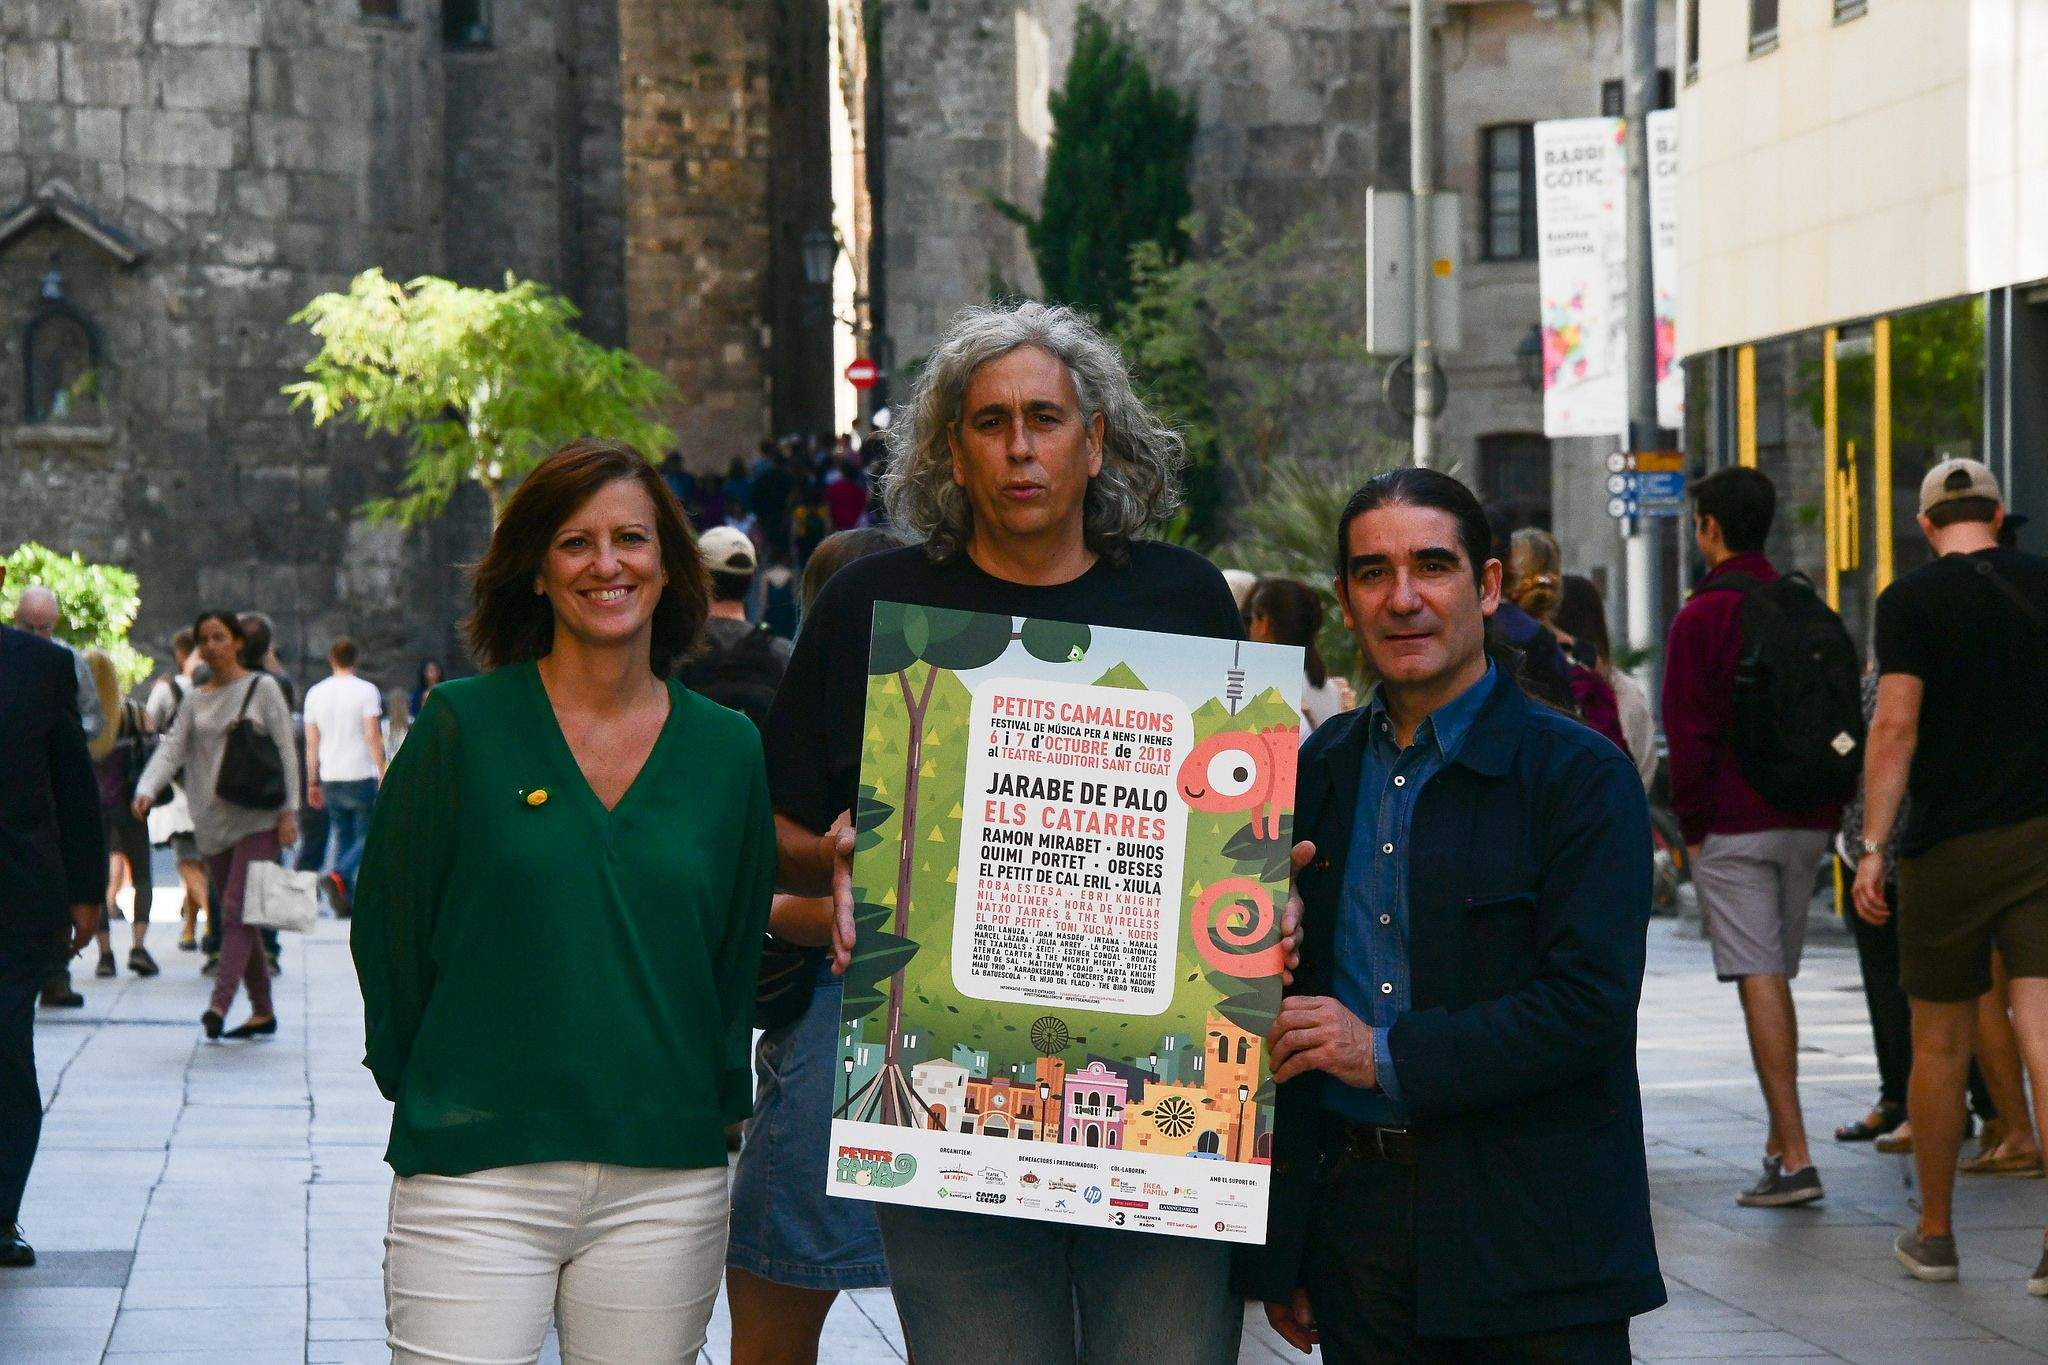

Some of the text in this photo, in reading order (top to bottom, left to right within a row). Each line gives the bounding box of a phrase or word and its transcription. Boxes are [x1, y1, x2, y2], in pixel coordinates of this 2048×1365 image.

[992, 695, 1173, 733] PETITS CAMALEONS
[990, 729, 1171, 763] 6 i 7 d'OCTUBRE de 2018
[991, 718, 1172, 746] FESTIVAL DE MÚSICA PER A NENS I NENES
[988, 745, 1170, 776] al TEATRE-AUDITORI SANT CUGAT
[985, 771, 1167, 813] JARABE DE PALO
[984, 800, 1165, 841] ELS CATARRES
[982, 827, 1164, 860] RAMON MIRABET BUHOS
[980, 845, 1162, 878] QUIMI PORTET OBESES
[979, 862, 1161, 895] EL PETIT DE CAL ERIL XIULA
[977, 890, 1159, 918] NIL MOLINER HORA DE JOGLAR
[978, 879, 1160, 907] ROBA ESTESA EBRI KNIGHT
[976, 912, 986, 922] EL
[992, 914, 1009, 925] POT
[1015, 916, 1041, 928] PETIT
[1055, 921, 1077, 932] TONI
[1128, 928, 1158, 941] KOERS
[977, 901, 1010, 913] NATXO
[1017, 903, 1058, 919] TARRÉS
[1077, 912, 1097, 923] THE
[1103, 915, 1159, 930] WIRELESS
[974, 930, 999, 940] MARCEL
[975, 923, 994, 931] JORDI
[1035, 930, 1052, 938] JOAN
[1129, 940, 1157, 949] MARALA
[1004, 949, 1032, 958] CARTER
[1044, 953, 1057, 961] THE
[1062, 955, 1089, 964] MIGHTY
[1064, 948, 1090, 957] ESTHER
[1093, 951, 1120, 960] CONDAL
[991, 962, 1005, 970] TRIO
[1072, 971, 1103, 981] CONCERTS
[1129, 978, 1155, 986] NADONS
[1029, 959, 1063, 969] MATTHEW
[1103, 967, 1126, 976] MARTA
[1130, 970, 1155, 979] KNIGHT
[1070, 979, 1089, 987] FLACO
[1112, 983, 1127, 991] BIRD
[1130, 985, 1154, 994] YELLOW
[1142, 1188, 1168, 1196] FAMILY
[1115, 1211, 1125, 1226] 3
